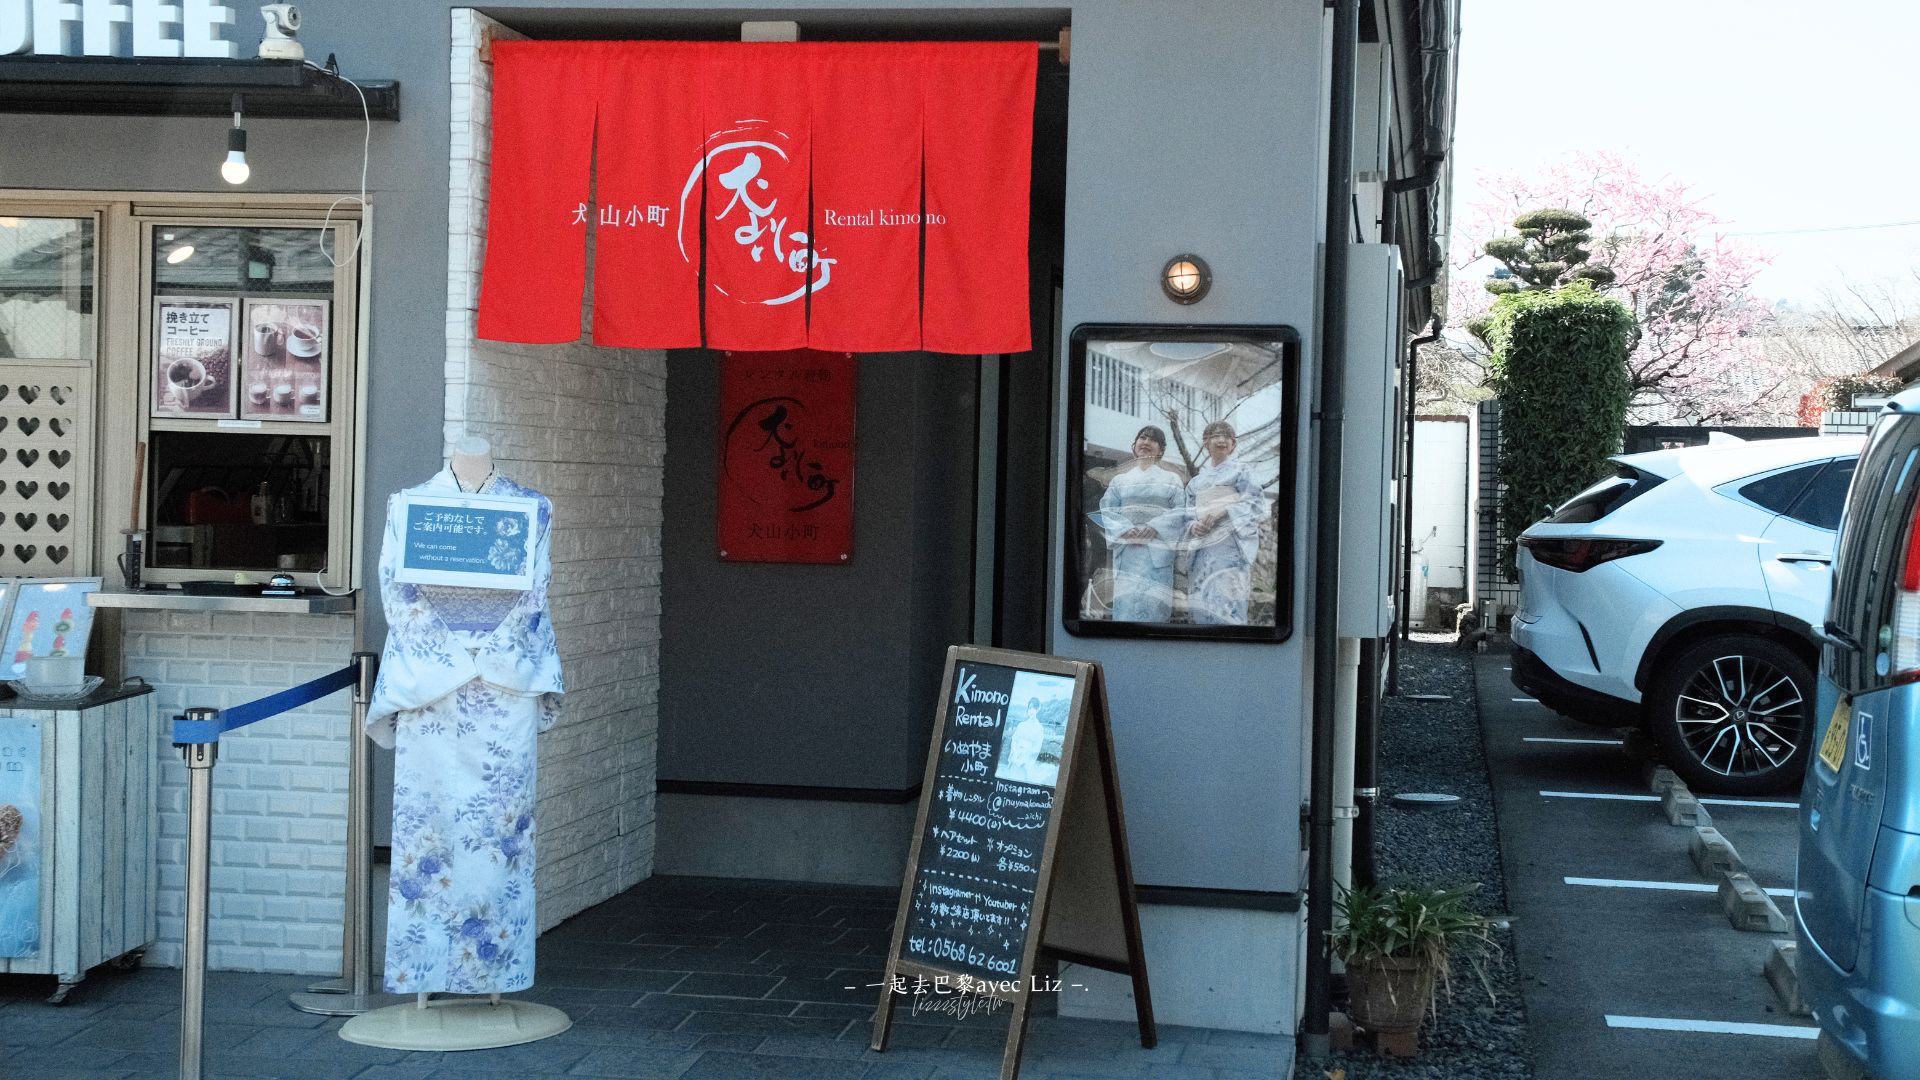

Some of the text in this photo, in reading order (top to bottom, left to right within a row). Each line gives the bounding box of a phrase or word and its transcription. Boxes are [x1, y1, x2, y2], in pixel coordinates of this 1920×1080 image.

[572, 202, 670, 227] 犬山小町
[824, 208, 946, 226] Rental kimono
[165, 311, 211, 325] 挽き立て
[167, 325, 210, 336] コーヒー
[424, 511, 485, 524] ご予約なしで
[413, 522, 488, 535] ご案内可能です。
[748, 523, 820, 540] 犬山小町
[413, 542, 425, 550] We
[419, 553, 444, 562] without
[954, 667, 1009, 705] Kimono
[955, 705, 1001, 728] Rental
[945, 740, 992, 759] いぬやま
[960, 759, 988, 776] 小町
[995, 781, 1041, 796] Instagram
[940, 830, 978, 845] ヘアセット
[996, 840, 1033, 858] オプション
